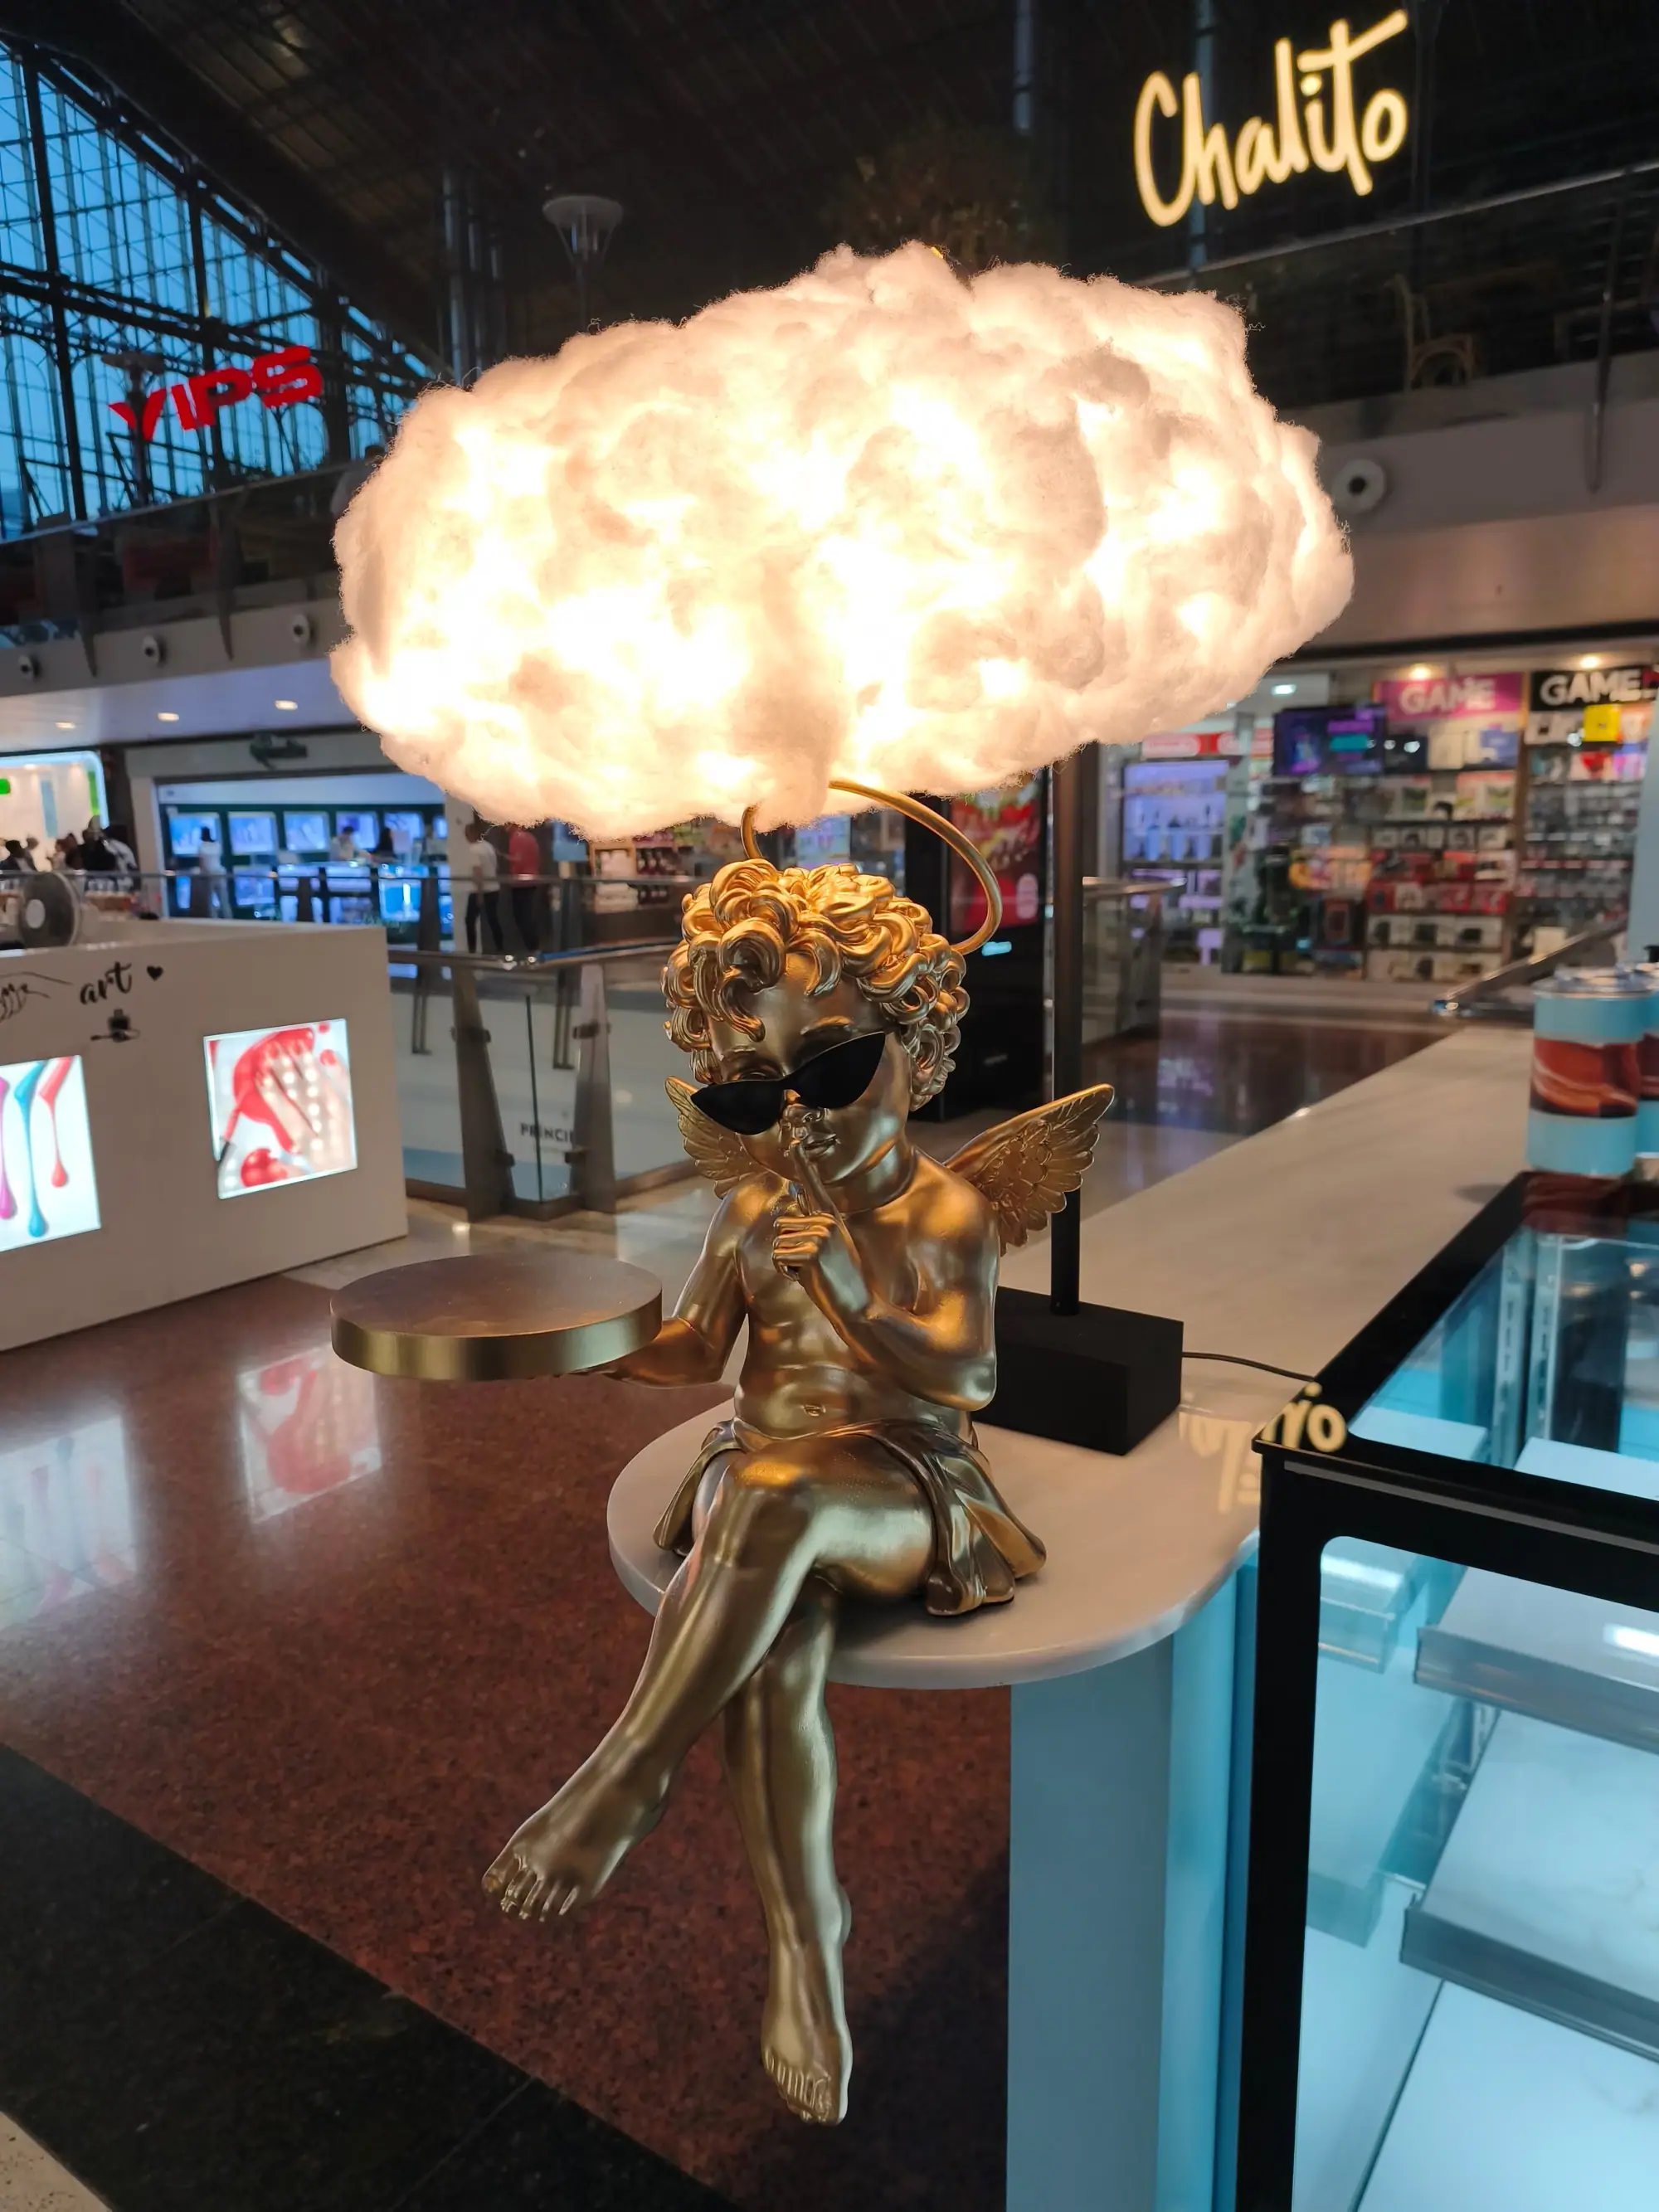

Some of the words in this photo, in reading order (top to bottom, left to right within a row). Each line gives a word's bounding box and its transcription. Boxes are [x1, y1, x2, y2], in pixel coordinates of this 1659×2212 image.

[1134, 10, 1408, 226] Chalito
[109, 345, 324, 440] VIPS
[1399, 678, 1495, 715] GAME
[1540, 668, 1642, 705] GAME
[79, 960, 133, 1004] art
